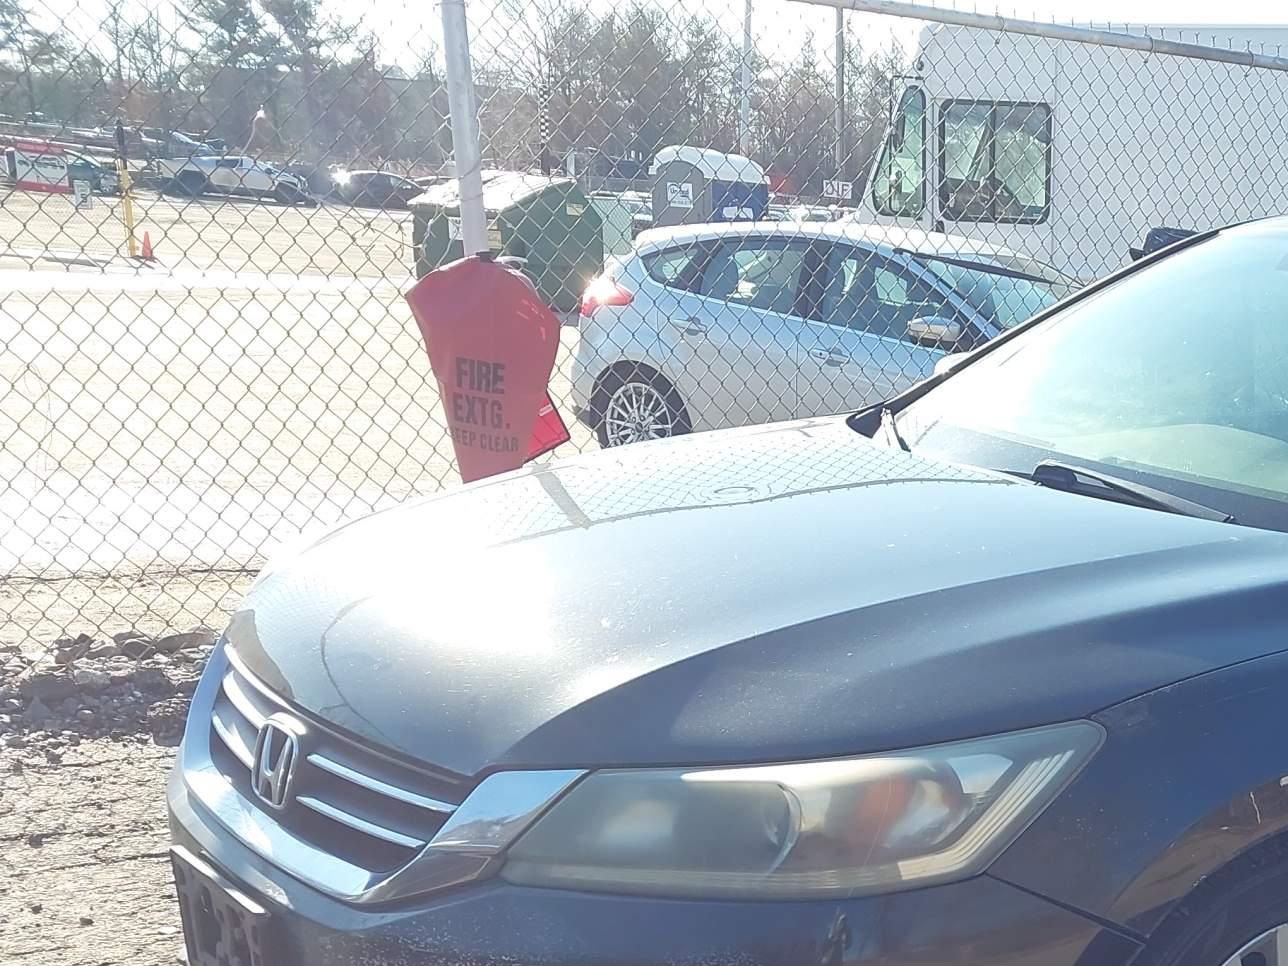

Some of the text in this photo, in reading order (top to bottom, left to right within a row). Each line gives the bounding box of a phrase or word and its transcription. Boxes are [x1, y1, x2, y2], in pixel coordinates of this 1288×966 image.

[456, 357, 505, 395] FIRE
[452, 392, 511, 430] EXTG.
[480, 433, 519, 452] CLEAR
